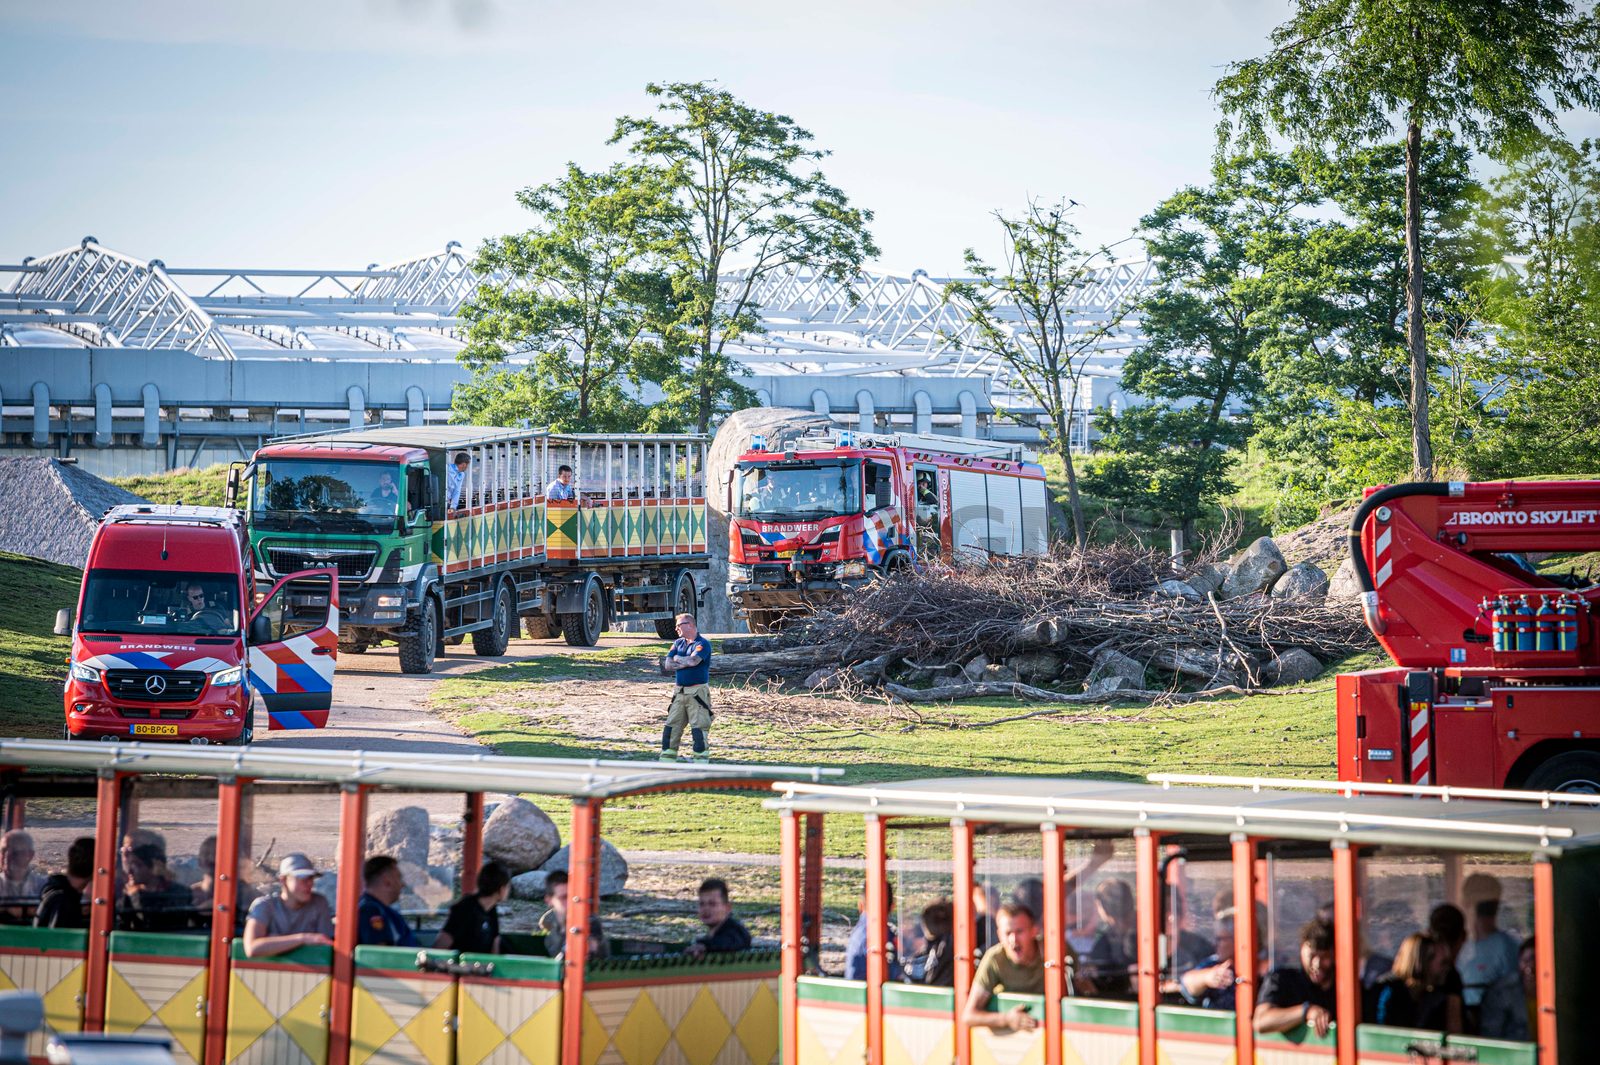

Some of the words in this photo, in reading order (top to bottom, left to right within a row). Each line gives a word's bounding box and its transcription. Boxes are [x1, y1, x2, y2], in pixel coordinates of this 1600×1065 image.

[1458, 511, 1528, 525] BRONTO
[1530, 510, 1598, 524] SKYLIFT
[761, 523, 819, 533] BRANDWEER
[303, 561, 338, 569] MAN
[136, 725, 175, 734] 80-BPG-6
